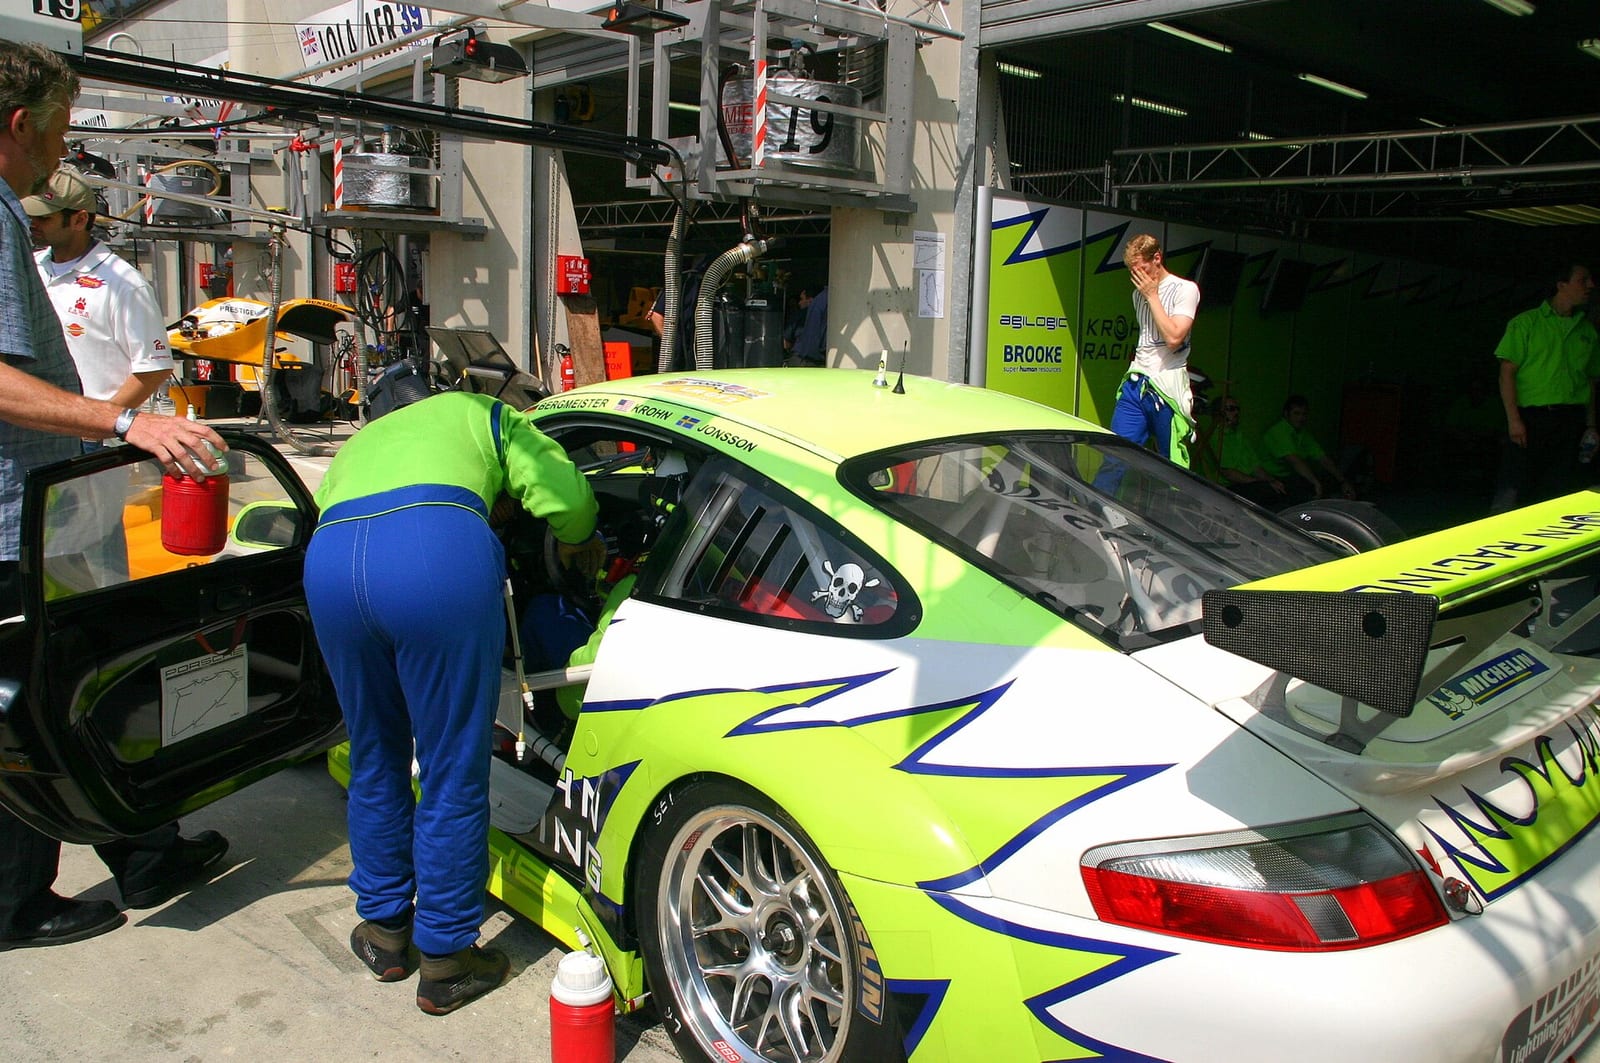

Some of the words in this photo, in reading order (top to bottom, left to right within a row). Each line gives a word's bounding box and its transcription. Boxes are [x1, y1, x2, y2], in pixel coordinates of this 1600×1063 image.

[396, 2, 423, 36] 39
[779, 95, 834, 154] 19
[219, 305, 254, 317] PRESTIGE
[1086, 315, 1140, 341] KROH
[1003, 345, 1062, 363] BROOKE
[538, 398, 609, 410] BERGMEISTER
[632, 403, 673, 421] KROHN
[697, 424, 758, 453] JONSSON
[1460, 653, 1536, 696] MICHELIN
[714, 1041, 741, 1061] BBS
